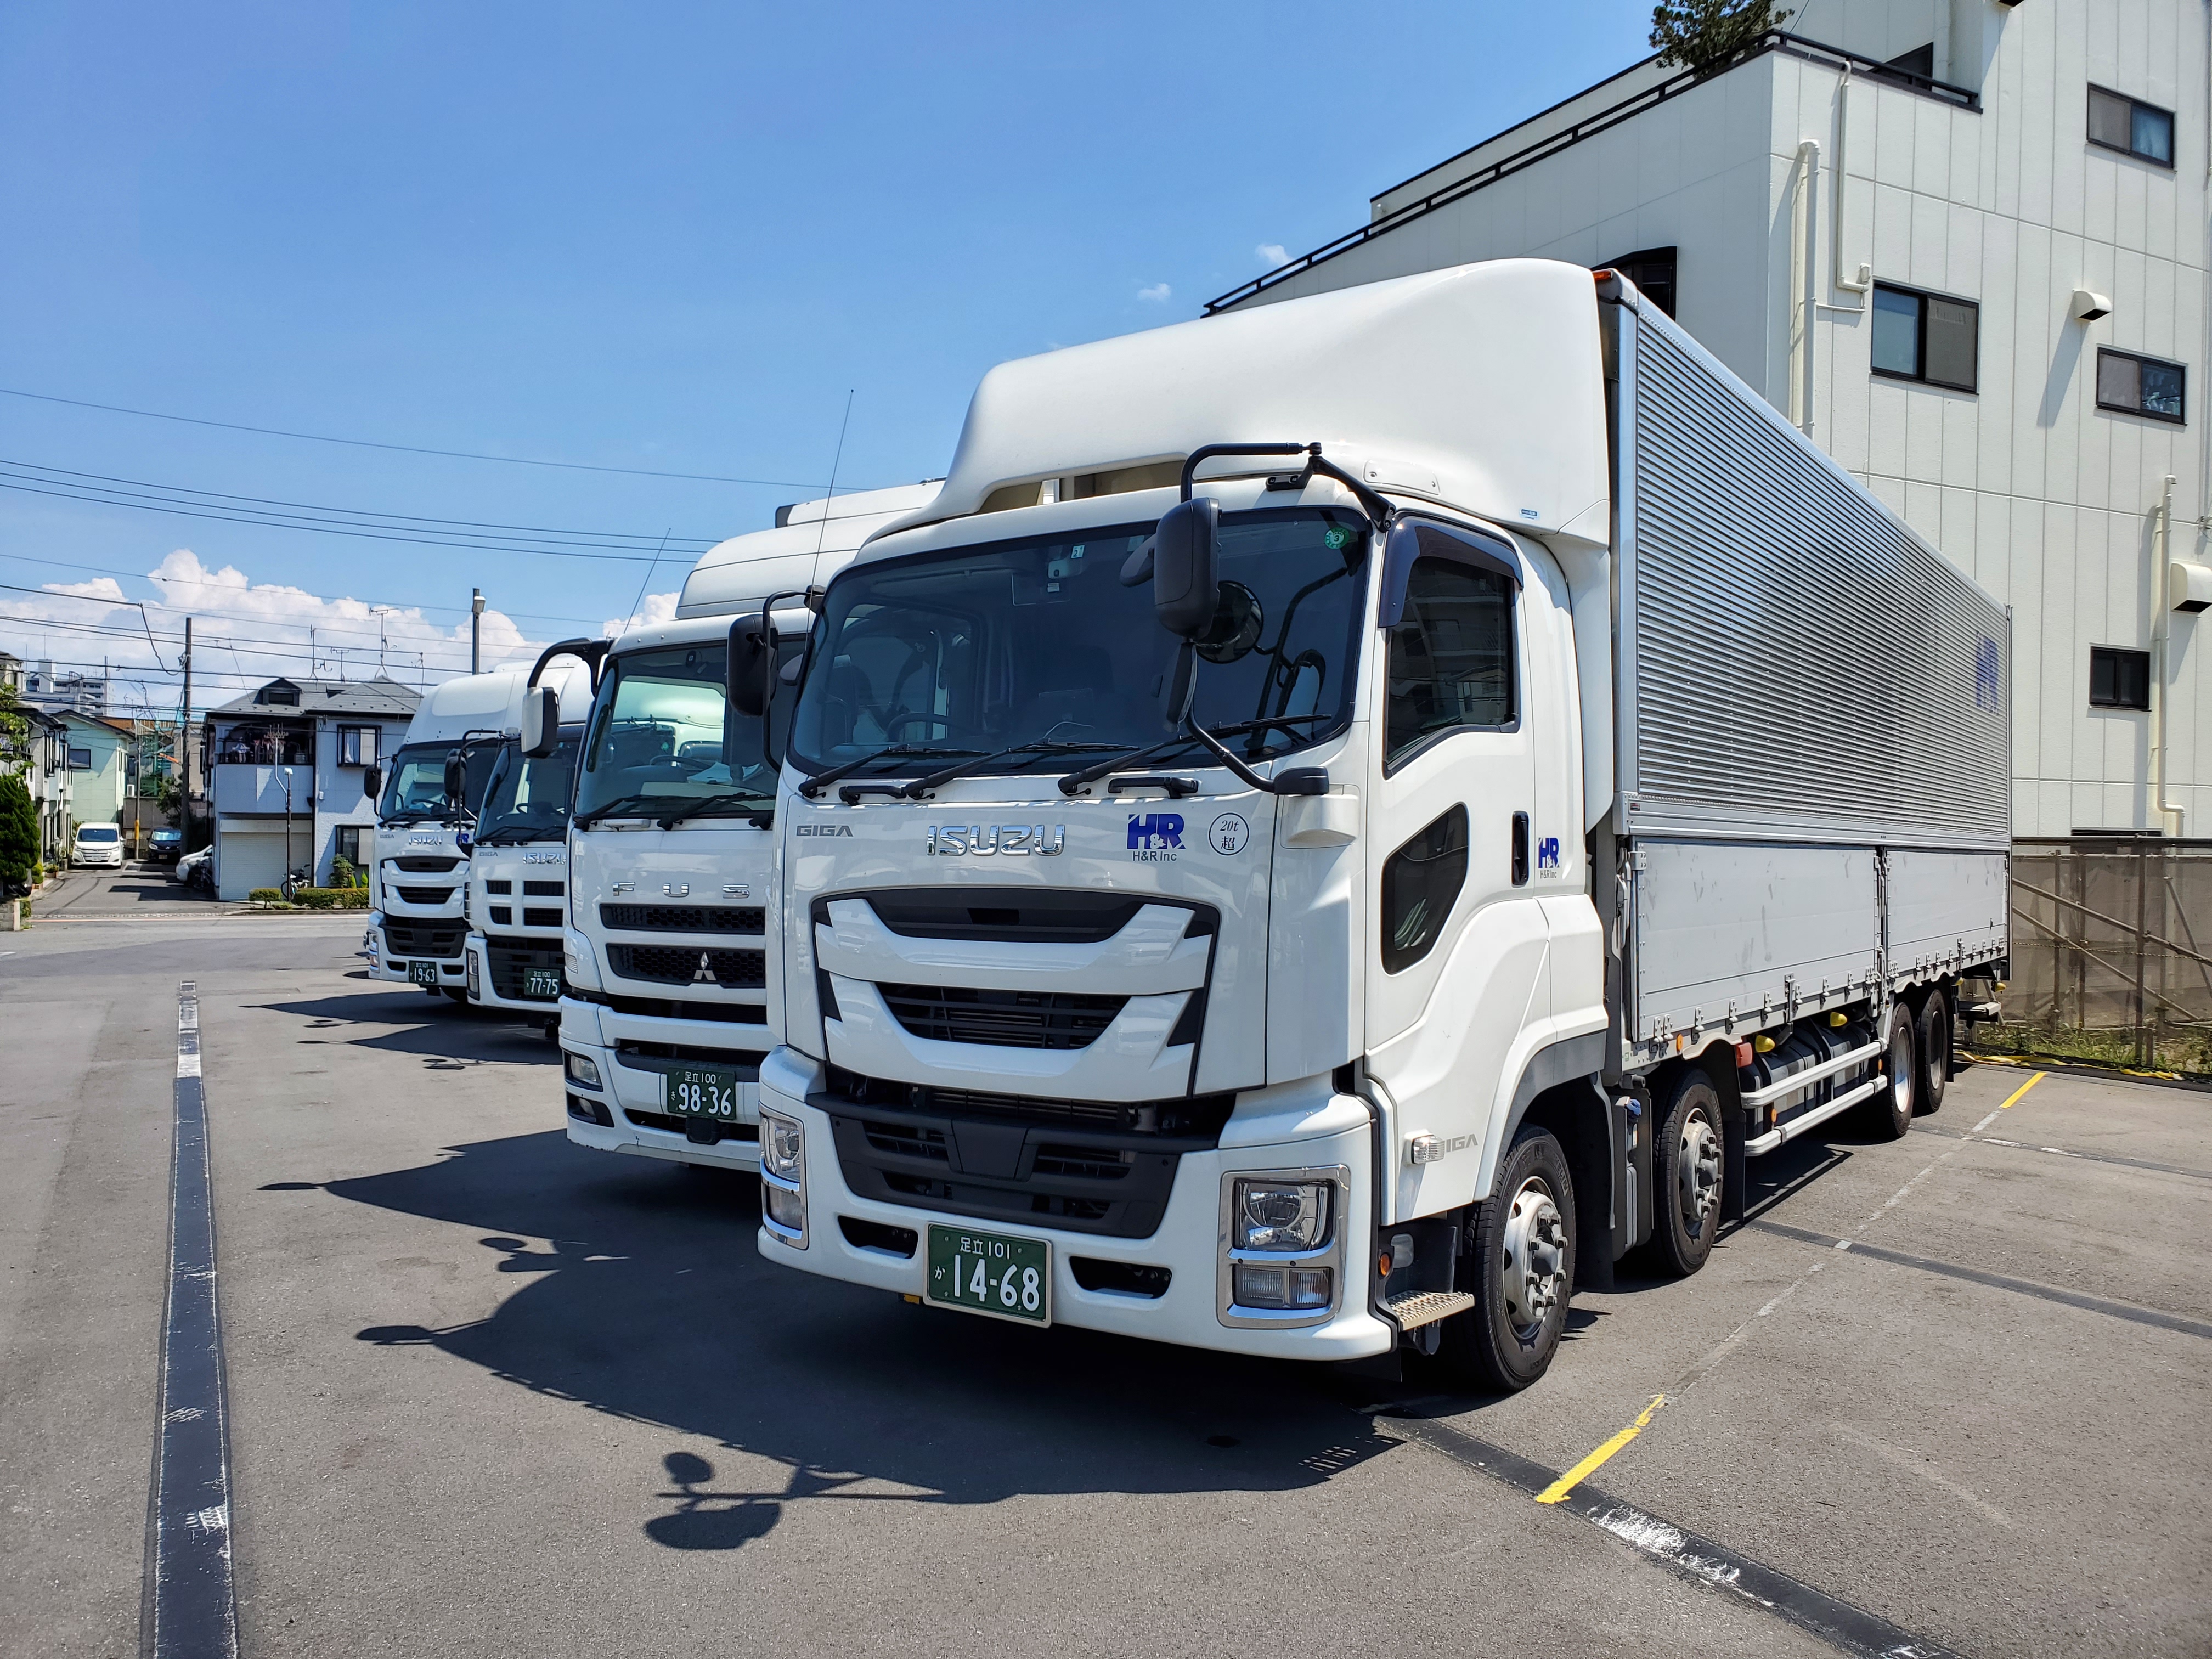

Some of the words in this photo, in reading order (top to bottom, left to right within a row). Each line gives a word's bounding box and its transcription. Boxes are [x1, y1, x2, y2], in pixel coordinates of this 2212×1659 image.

[796, 825, 854, 837] GIGA
[1220, 820, 1239, 832] 20t
[409, 835, 443, 845] ISUZU
[927, 825, 1065, 856] ISUZU
[1220, 836, 1235, 851] 超
[523, 852, 566, 865] ISUZU
[1132, 851, 1158, 861] H&R
[1160, 851, 1177, 861] Inc
[612, 882, 750, 899] FUS
[414, 967, 435, 982] 19-63
[530, 977, 558, 995] 77-75
[678, 1083, 732, 1116] 98-36
[1445, 1133, 1478, 1153] IGA
[934, 1266, 946, 1280] か
[955, 1254, 1040, 1311] 14-68
